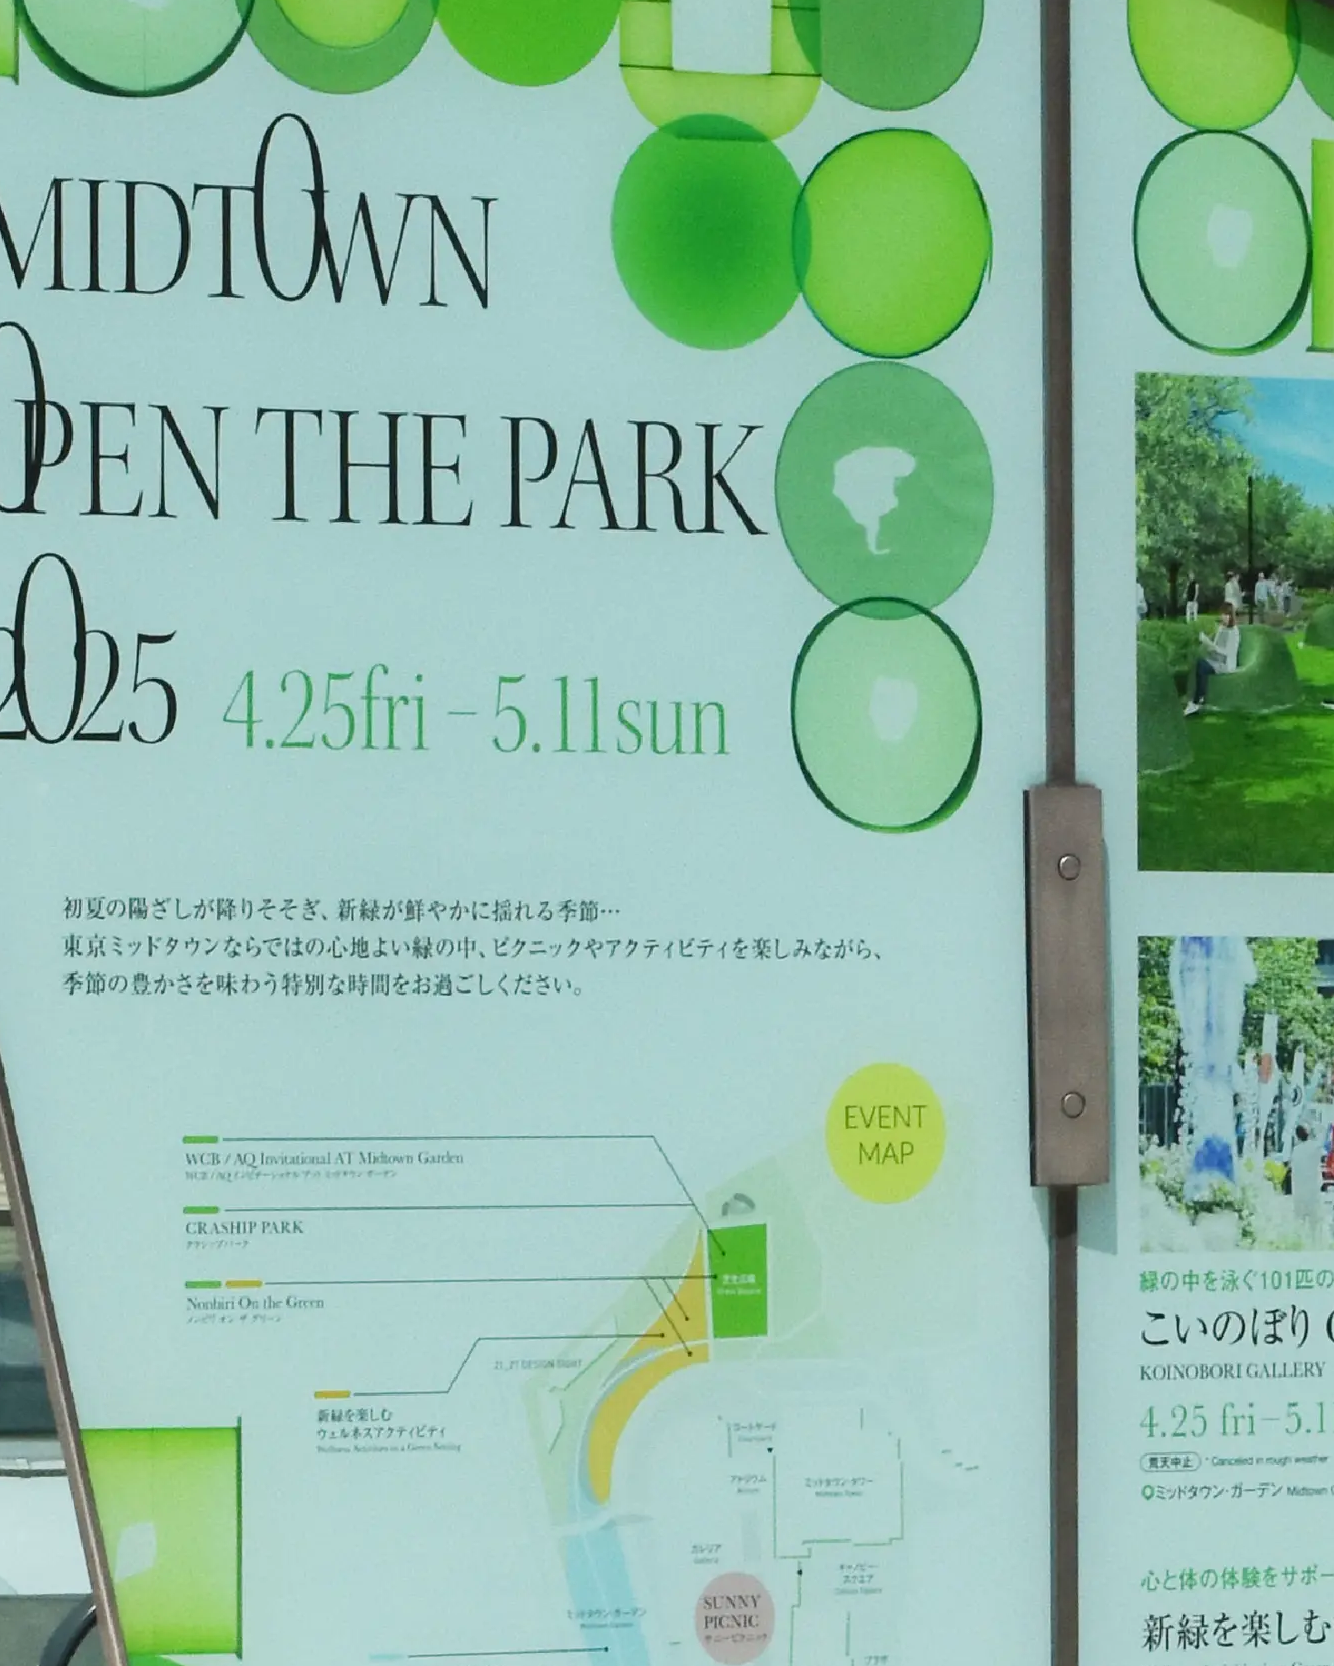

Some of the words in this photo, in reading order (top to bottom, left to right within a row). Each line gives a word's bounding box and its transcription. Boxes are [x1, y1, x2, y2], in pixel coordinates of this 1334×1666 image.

[254, 406, 474, 527] THE
[500, 415, 768, 536] PARK
[63, 971, 583, 999] 季節の豊かさを味わう特別な時間をお過ごしください。
[844, 1104, 927, 1130] EVENT
[185, 1152, 222, 1166] WCB
[234, 1153, 257, 1168] AQ
[260, 1151, 331, 1165] Invitational
[334, 1151, 354, 1164] AT
[359, 1151, 414, 1164] Midtown
[417, 1151, 464, 1164] Garden
[858, 1141, 914, 1165] MAP
[186, 1221, 256, 1234] CRASHIP
[262, 1221, 304, 1234] PARK
[186, 1296, 235, 1311] Nonbiri
[239, 1297, 259, 1310] On
[263, 1296, 282, 1309] the
[285, 1296, 324, 1310] Green
[1141, 1303, 1309, 1348] こいのぼり
[1139, 1363, 1242, 1381] KOINOBORI
[1246, 1361, 1326, 1379] GALLERY
[1139, 1403, 1208, 1438] 4.25
[703, 1594, 762, 1610] SUNNY
[703, 1614, 759, 1630] PICNIC
